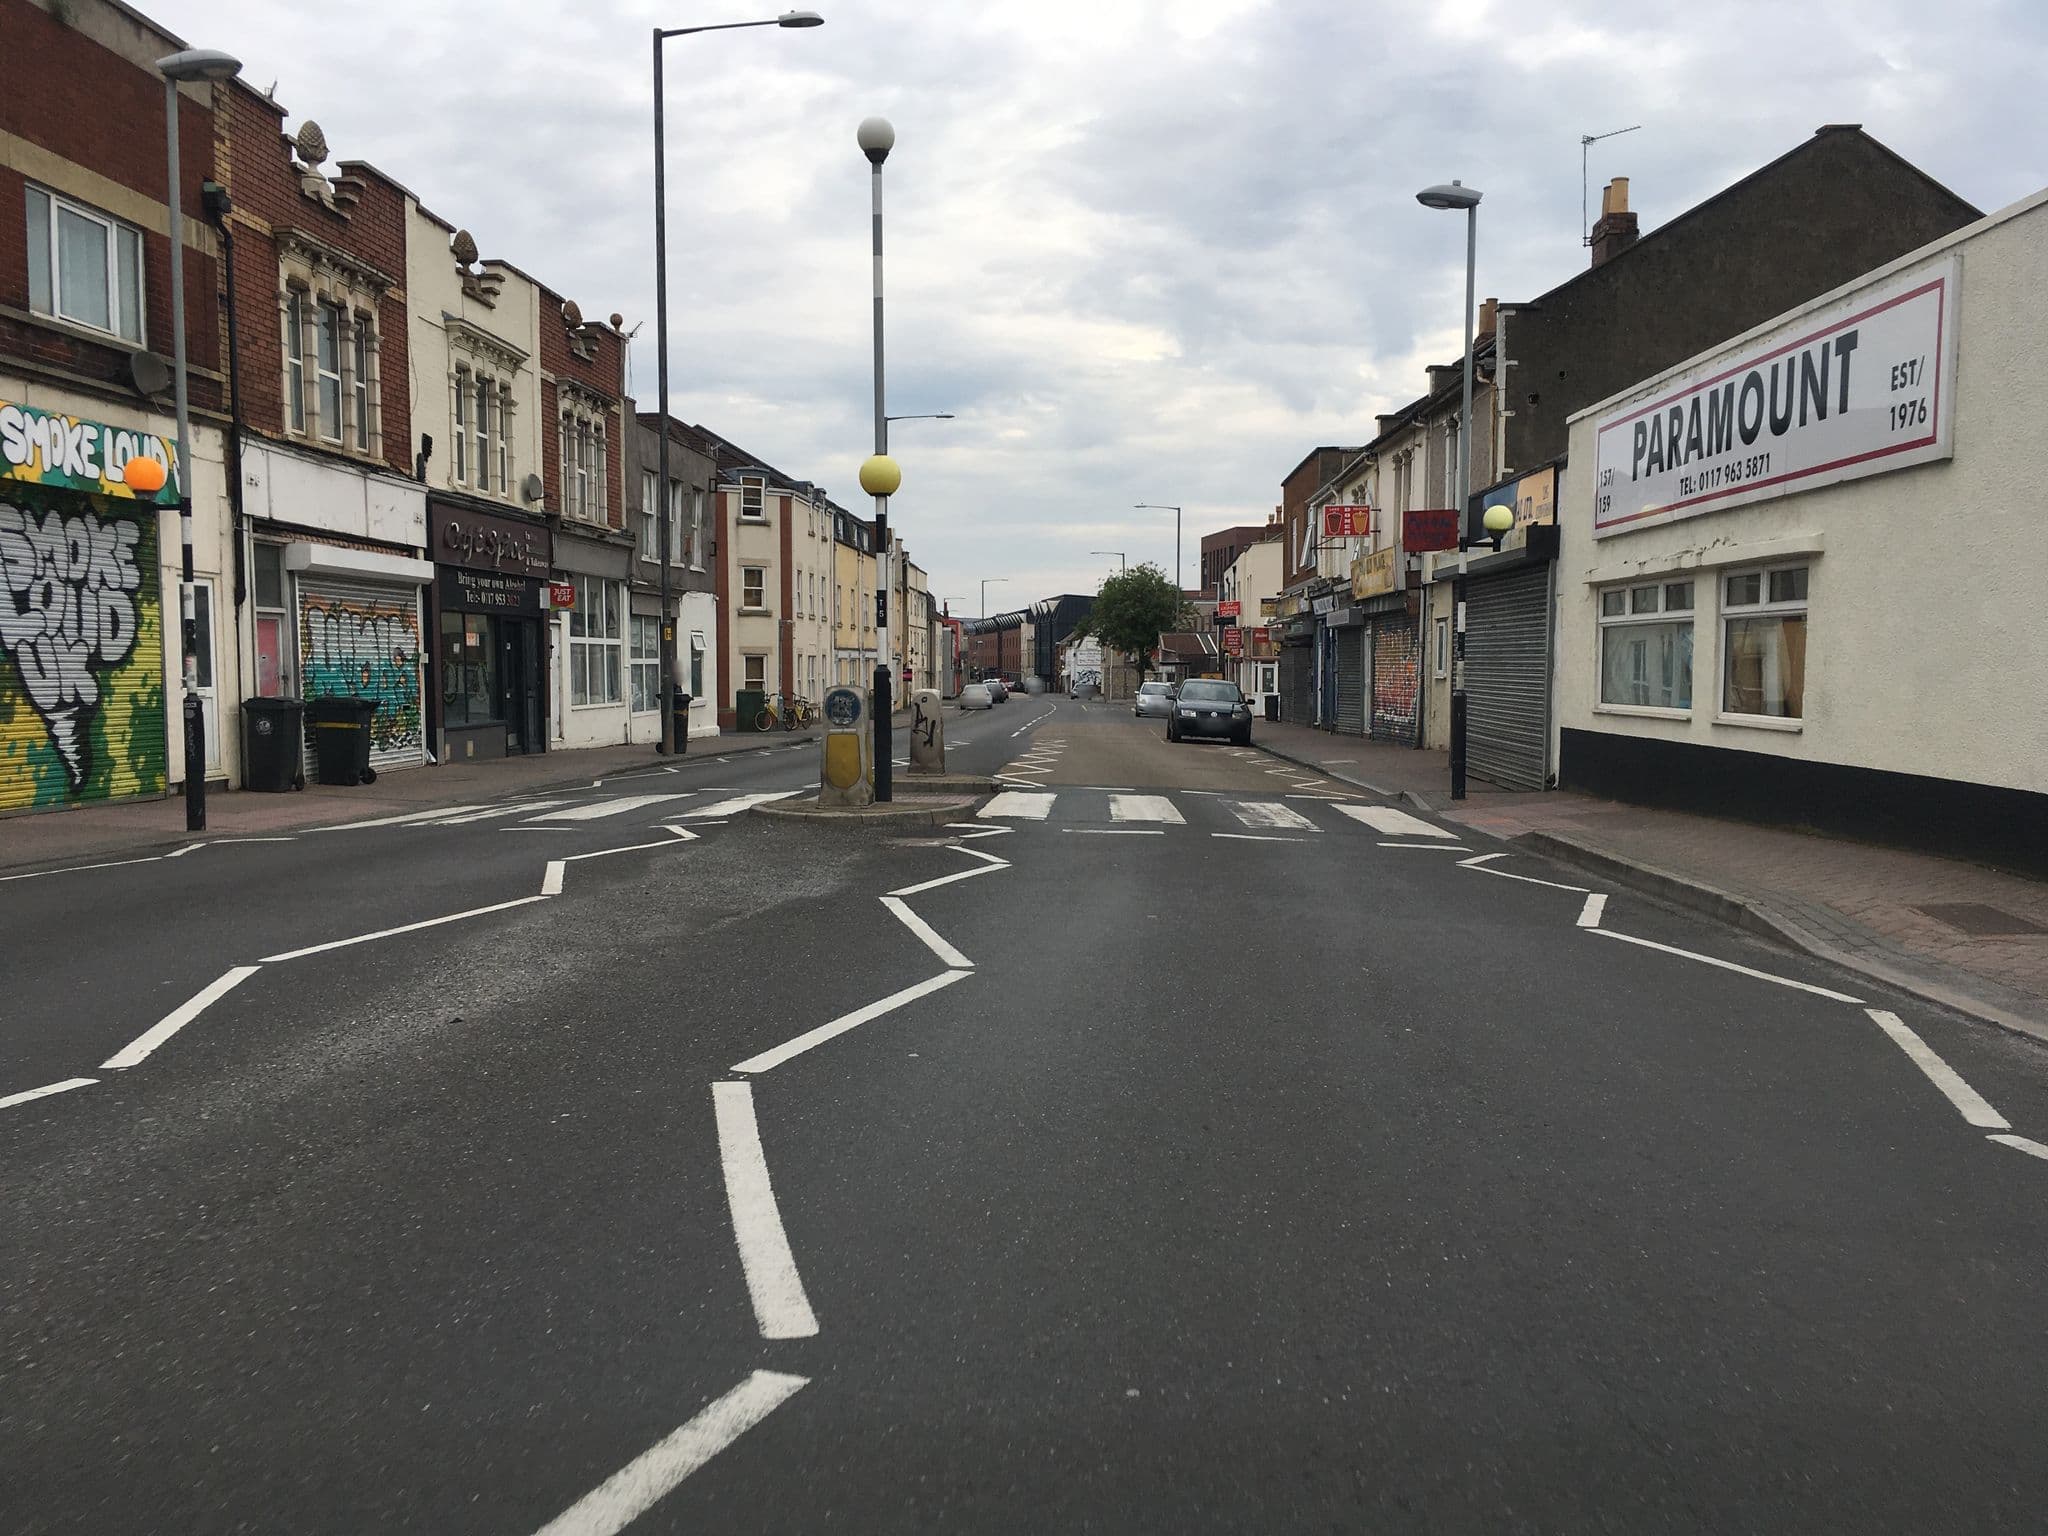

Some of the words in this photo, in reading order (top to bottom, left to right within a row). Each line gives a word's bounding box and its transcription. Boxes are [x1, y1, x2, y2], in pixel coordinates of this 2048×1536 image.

[1632, 329, 1858, 482] PARAMOUNT
[1890, 397, 1927, 431] 1976
[0, 405, 100, 480] SMOKE
[1680, 477, 1697, 496] TEL:
[1699, 467, 1721, 492] 0117
[1724, 462, 1742, 485] 963
[1745, 453, 1771, 479] 5871
[1599, 495, 1611, 514] 159
[0, 502, 141, 592] SMOKE
[0, 557, 136, 662] LOUD
[458, 571, 476, 588] Bring
[477, 577, 491, 589] your
[492, 579, 504, 590] own
[553, 588, 571, 596] JUST
[15, 631, 98, 710] UK
